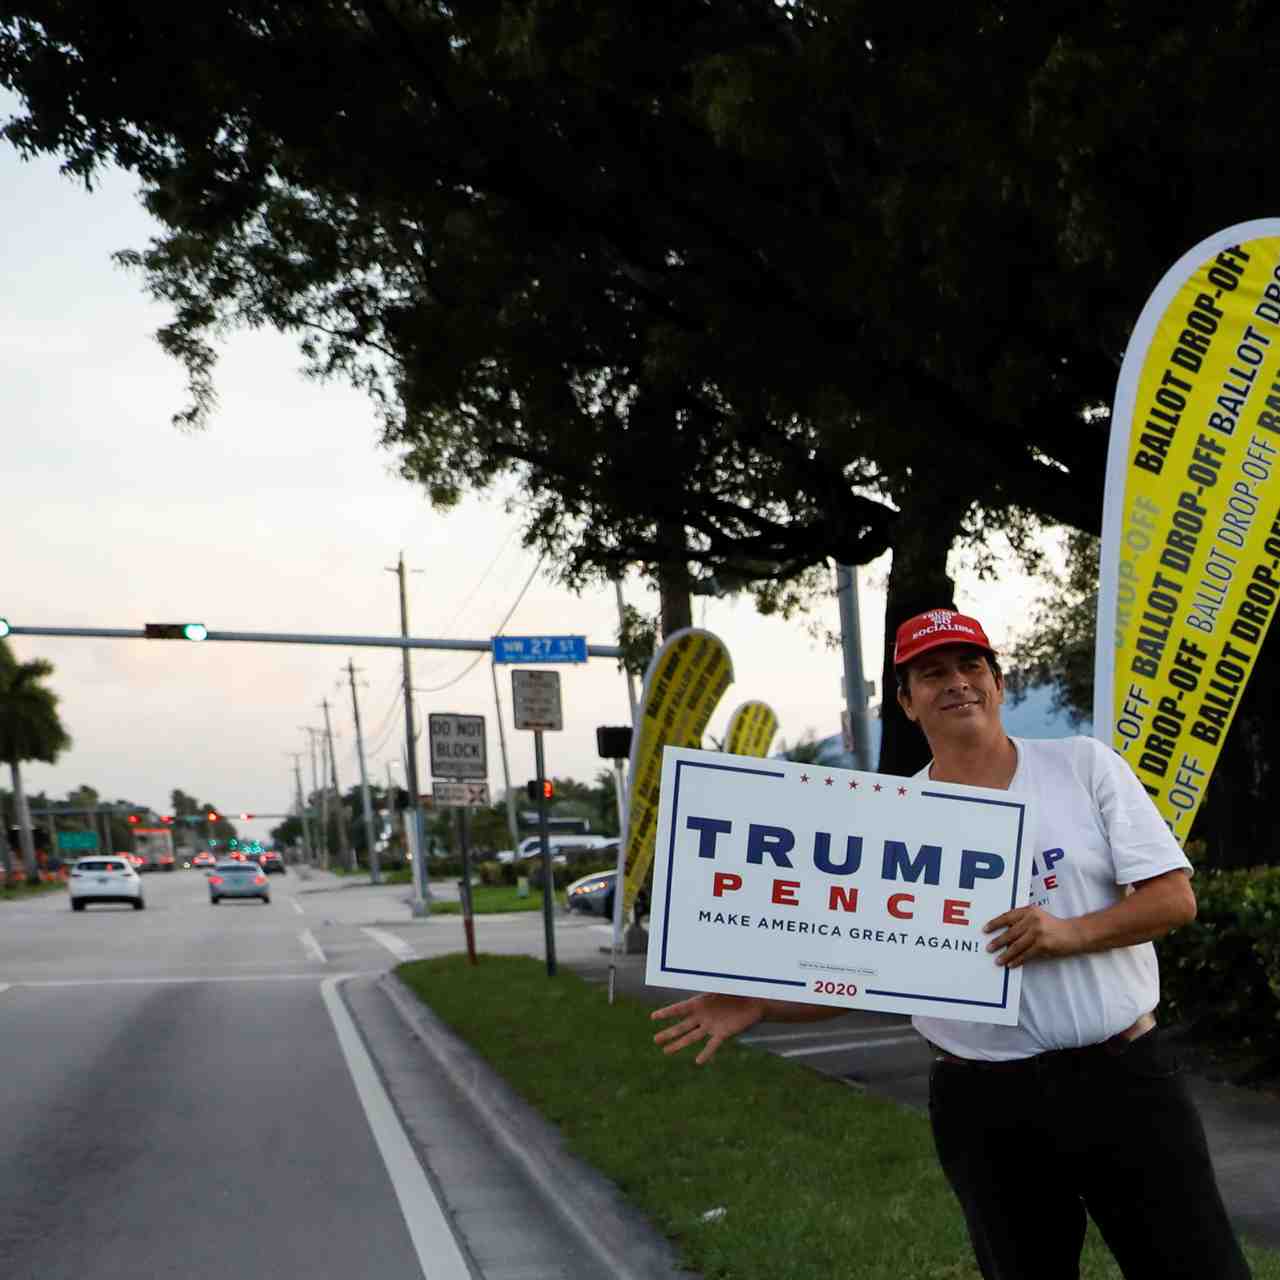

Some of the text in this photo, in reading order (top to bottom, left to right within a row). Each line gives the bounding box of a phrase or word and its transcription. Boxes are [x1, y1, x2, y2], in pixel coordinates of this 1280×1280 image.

[1133, 369, 1193, 475] BALLOT
[1170, 244, 1251, 374] DROP-OFF
[1131, 571, 1184, 680] BALLOT
[1160, 433, 1227, 575] DROP-OFF
[1208, 325, 1271, 436] BALLOT
[530, 638, 553, 657] 27
[1138, 637, 1208, 778] DROP-OFF
[1187, 546, 1237, 634] BALLOT
[1190, 641, 1252, 747] BALLOT
[436, 742, 481, 758] BLOCK
[687, 816, 1005, 890] TRUMP
[699, 910, 980, 953] MAKE AMERICA GREAT AGAIN!
[712, 872, 972, 927] PENCE
[814, 980, 858, 997] 2020
